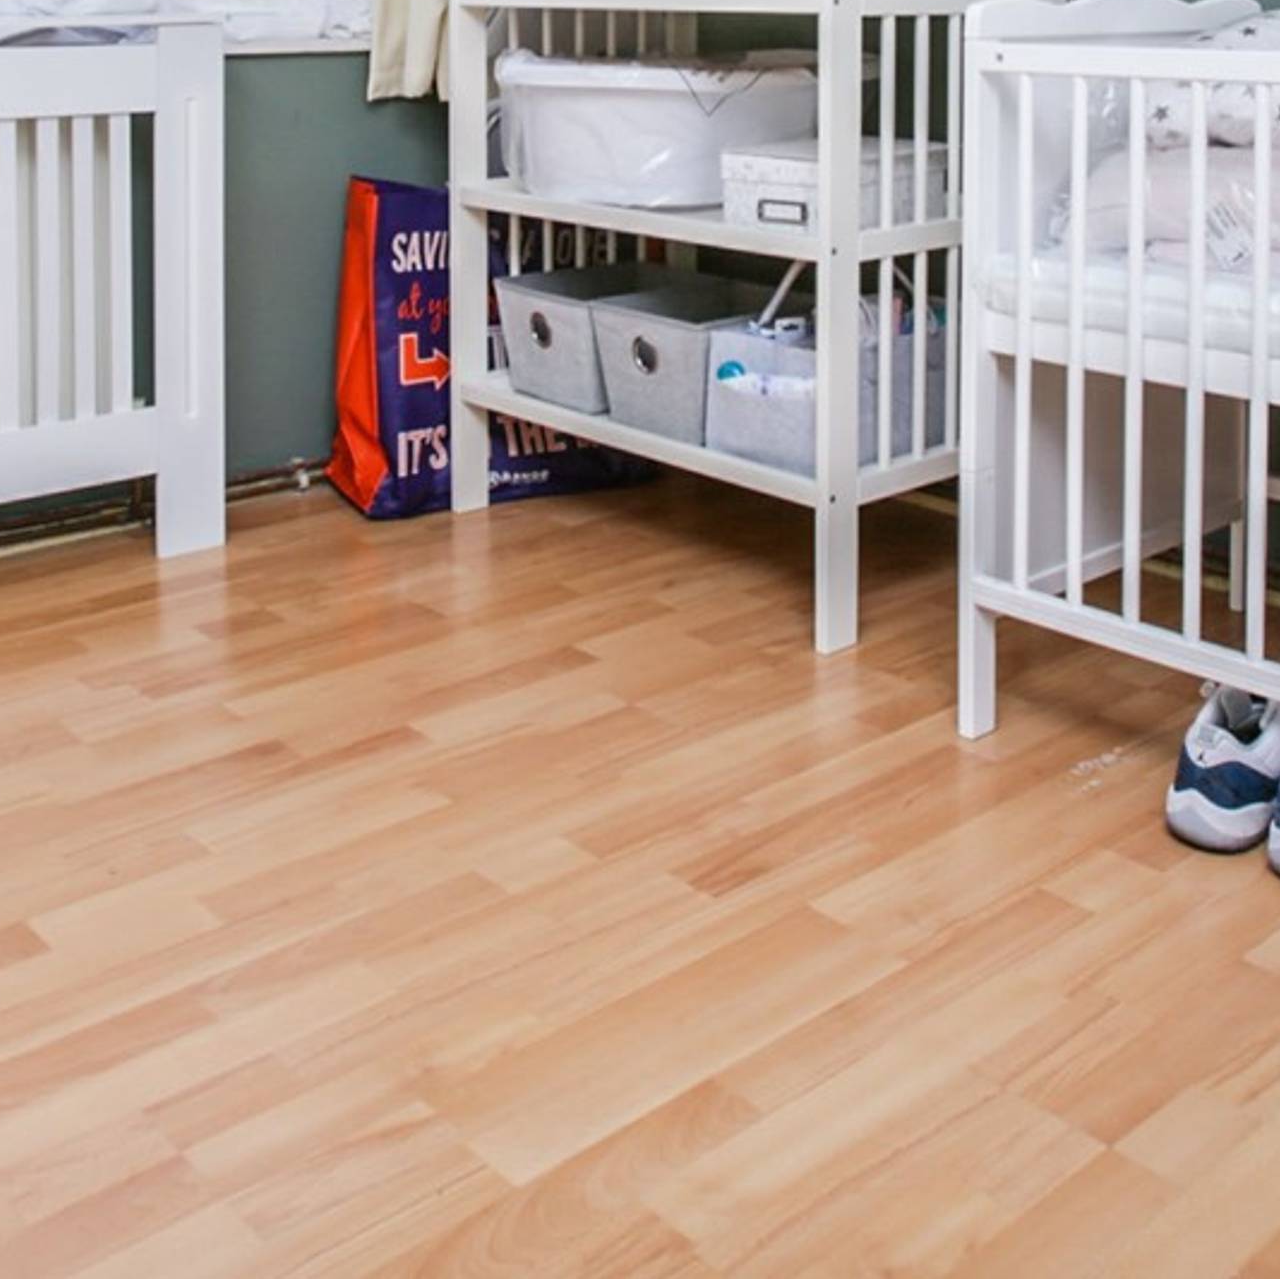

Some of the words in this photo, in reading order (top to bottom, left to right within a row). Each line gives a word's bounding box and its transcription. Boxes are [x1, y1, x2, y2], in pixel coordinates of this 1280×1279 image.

[391, 231, 449, 273] SAVI
[398, 281, 423, 320] at
[397, 424, 449, 478] IT'S
